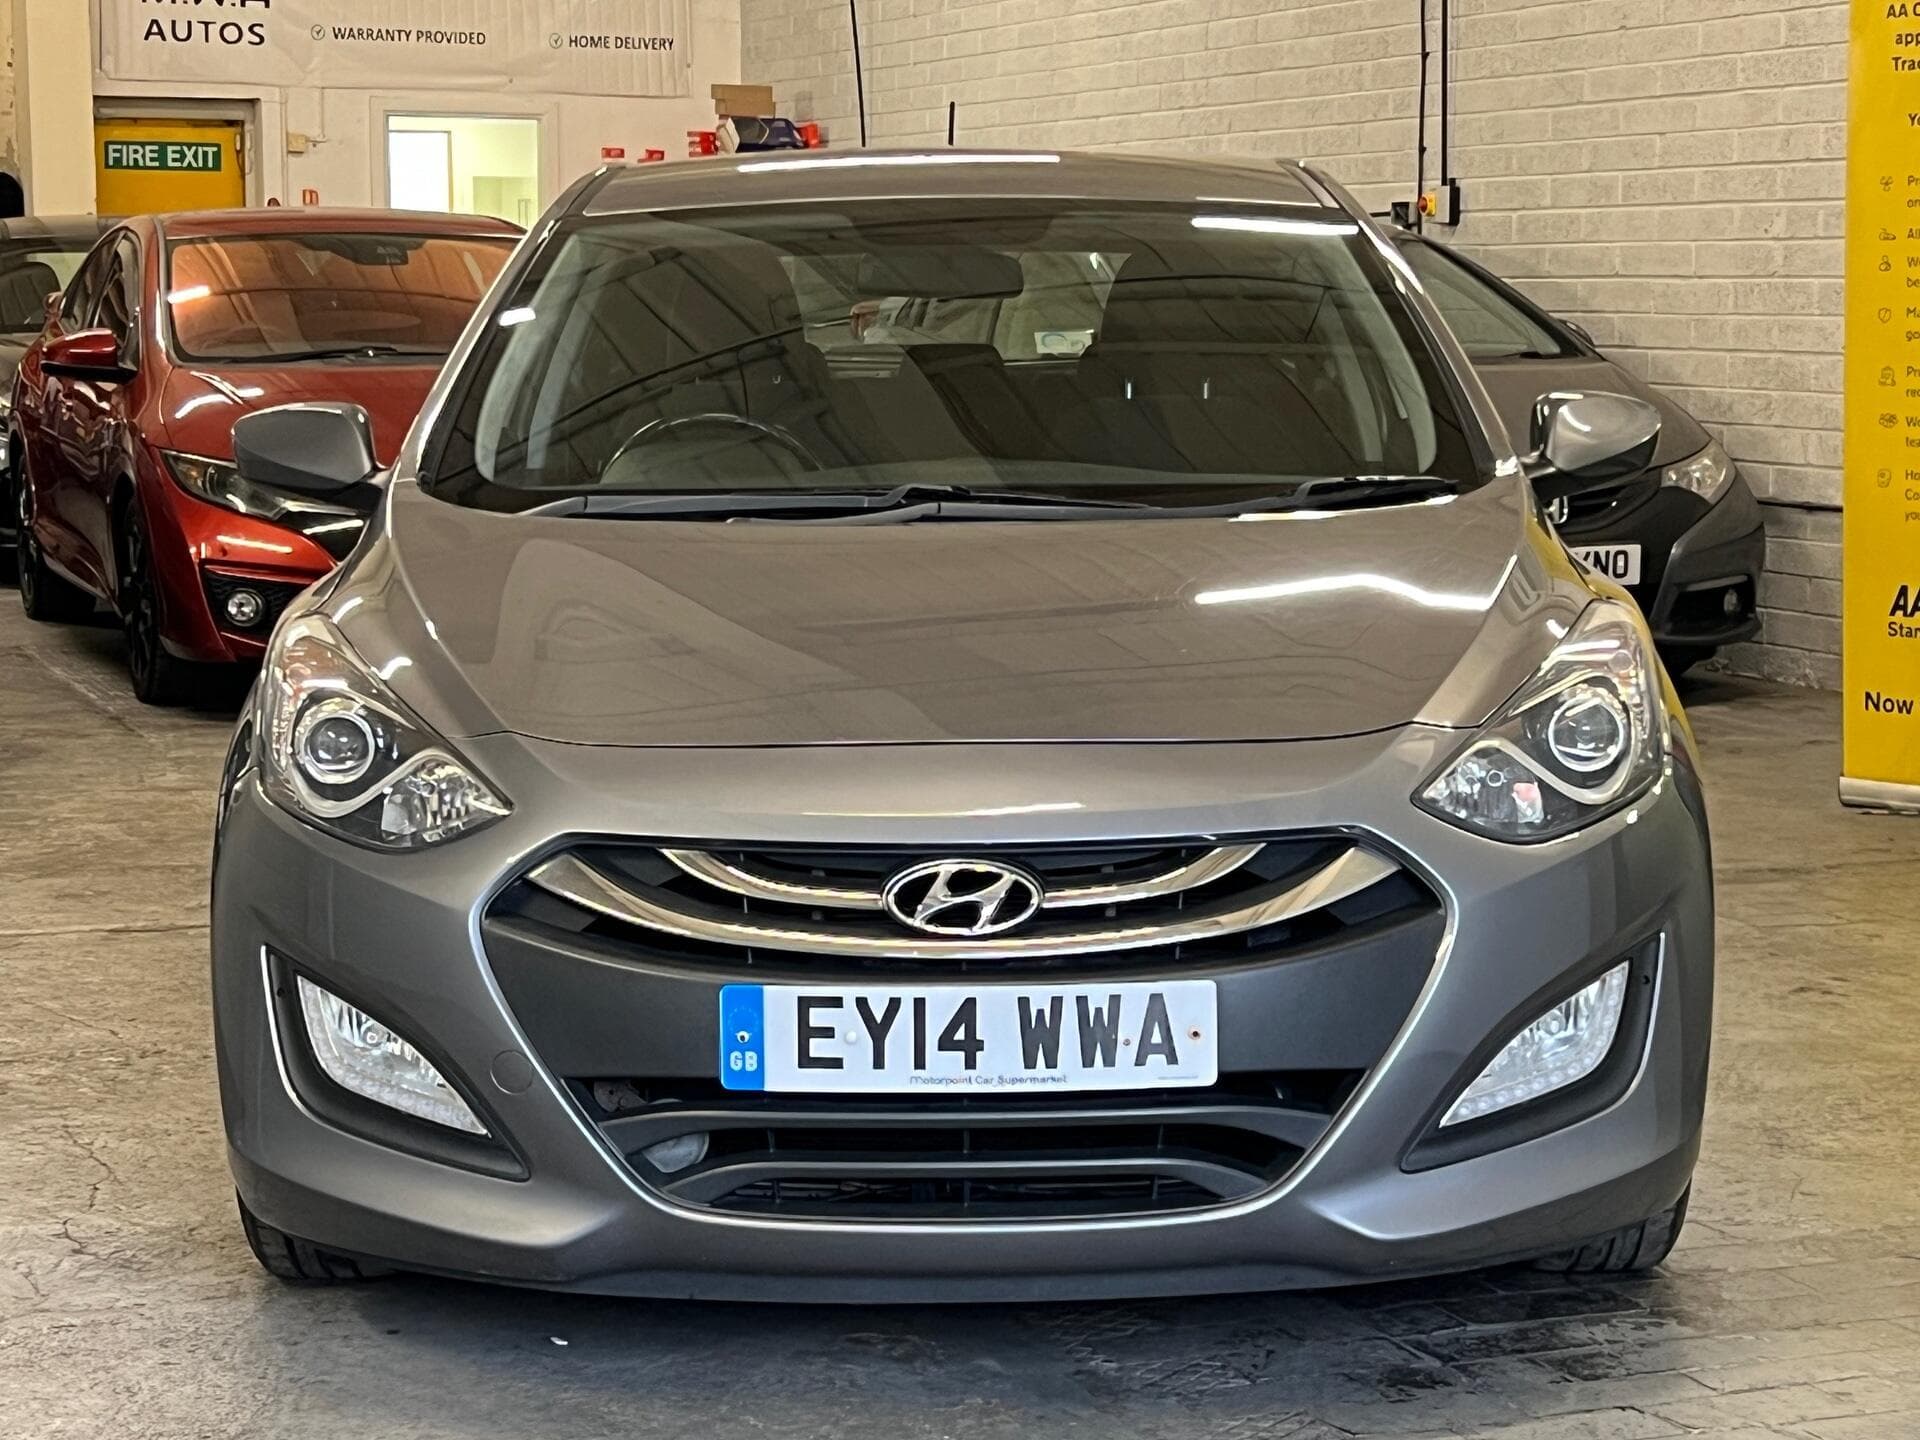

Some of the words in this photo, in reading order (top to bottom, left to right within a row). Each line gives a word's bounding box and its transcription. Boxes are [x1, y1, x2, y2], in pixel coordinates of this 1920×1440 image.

[1886, 3, 1908, 19] AA
[143, 18, 266, 46] AUTOS
[332, 26, 412, 42] WARRANTY
[416, 30, 486, 45] PROVIDED
[568, 35, 611, 49] HOME
[614, 36, 674, 51] DELIVERY
[108, 144, 159, 167] FIRE
[167, 145, 218, 168] EXIT
[1864, 691, 1914, 715] Now
[797, 996, 984, 1070] EY14
[1017, 993, 1178, 1069] WWA
[729, 1051, 758, 1072] GB
[910, 1075, 972, 1087] Motorpoint
[975, 1075, 993, 1085] Car
[997, 1074, 1068, 1086] Supermarket
